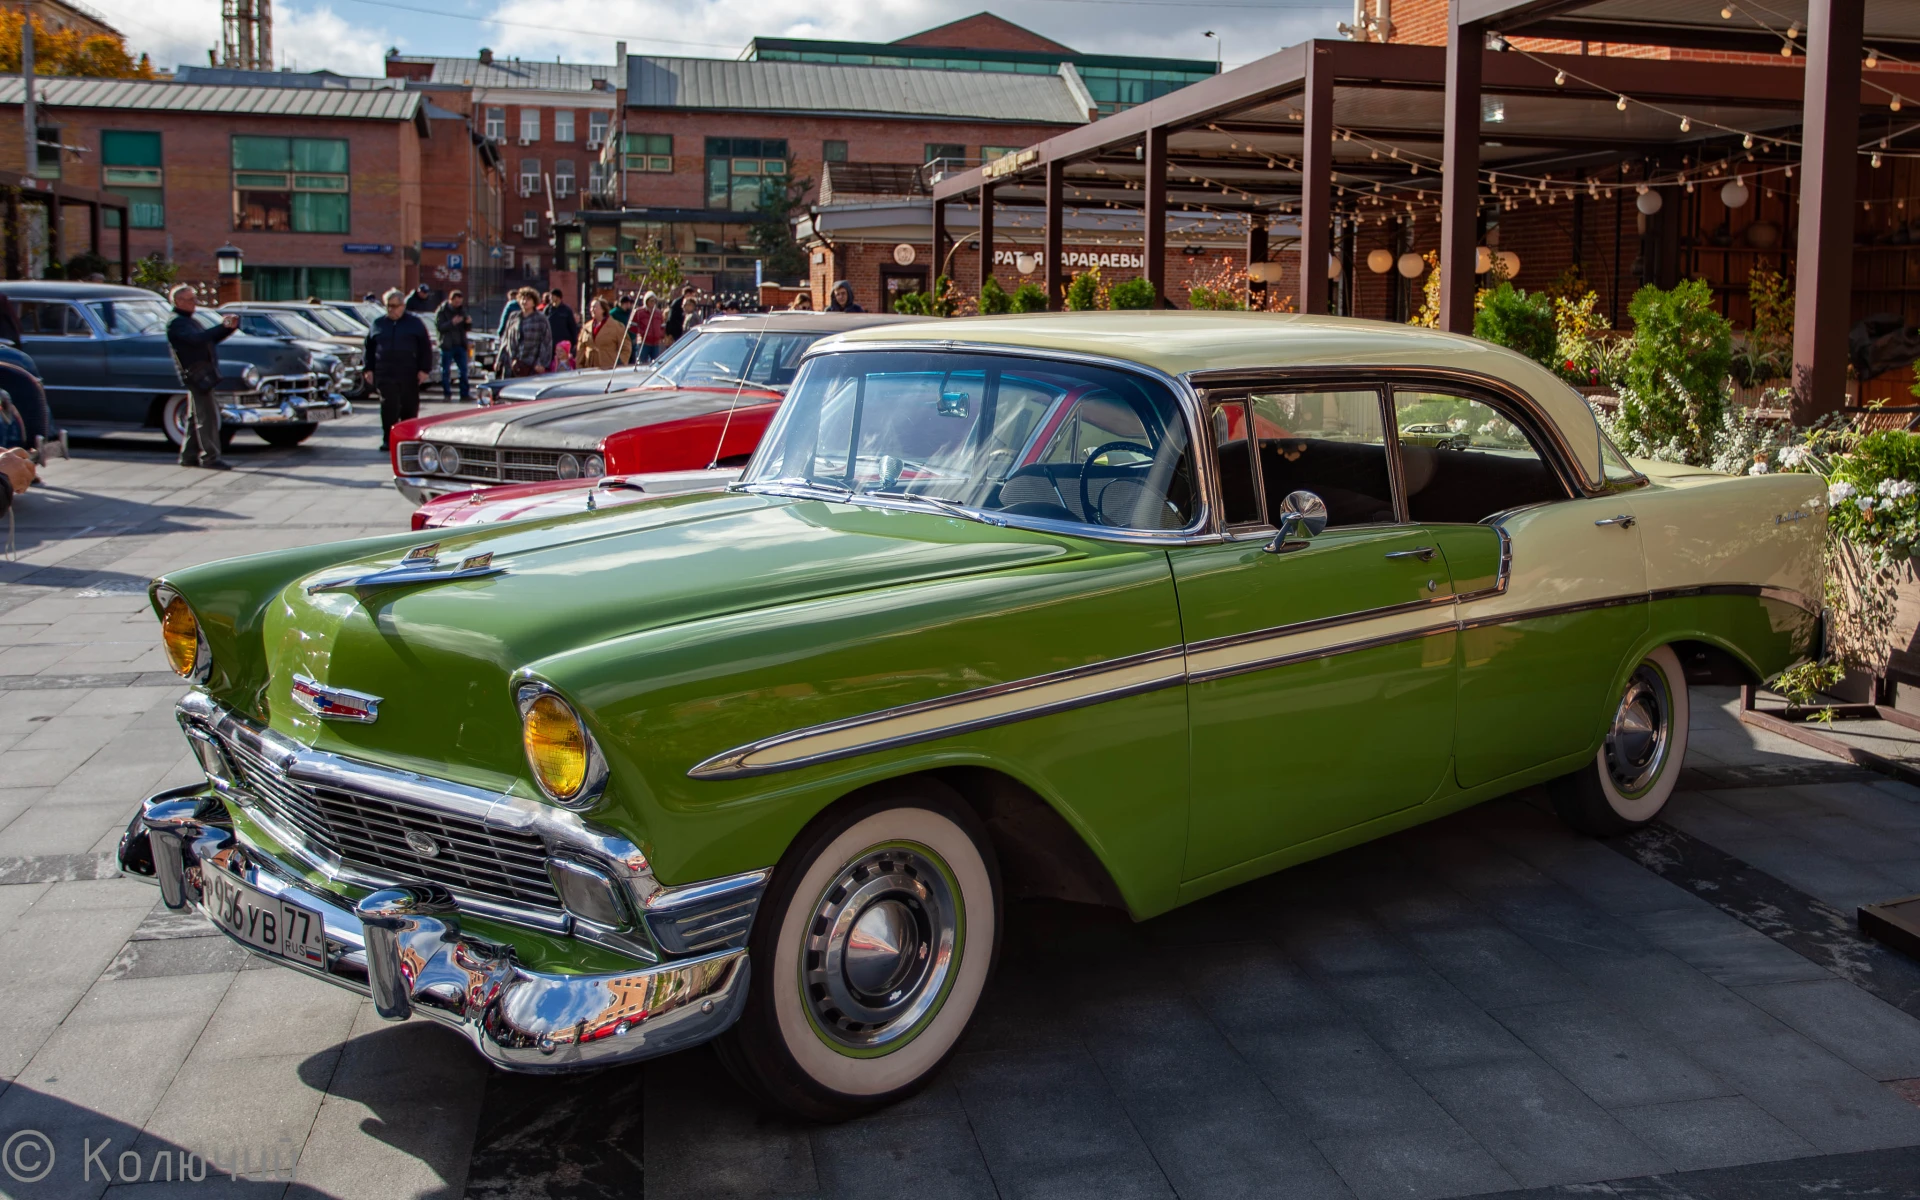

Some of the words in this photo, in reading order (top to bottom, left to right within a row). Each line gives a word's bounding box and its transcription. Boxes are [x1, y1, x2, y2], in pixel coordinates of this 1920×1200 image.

[992, 251, 1044, 266] РАТЯ
[1061, 252, 1144, 268] АРАВАЕВЫ
[285, 907, 311, 944] 77
[285, 940, 306, 956] RUS
